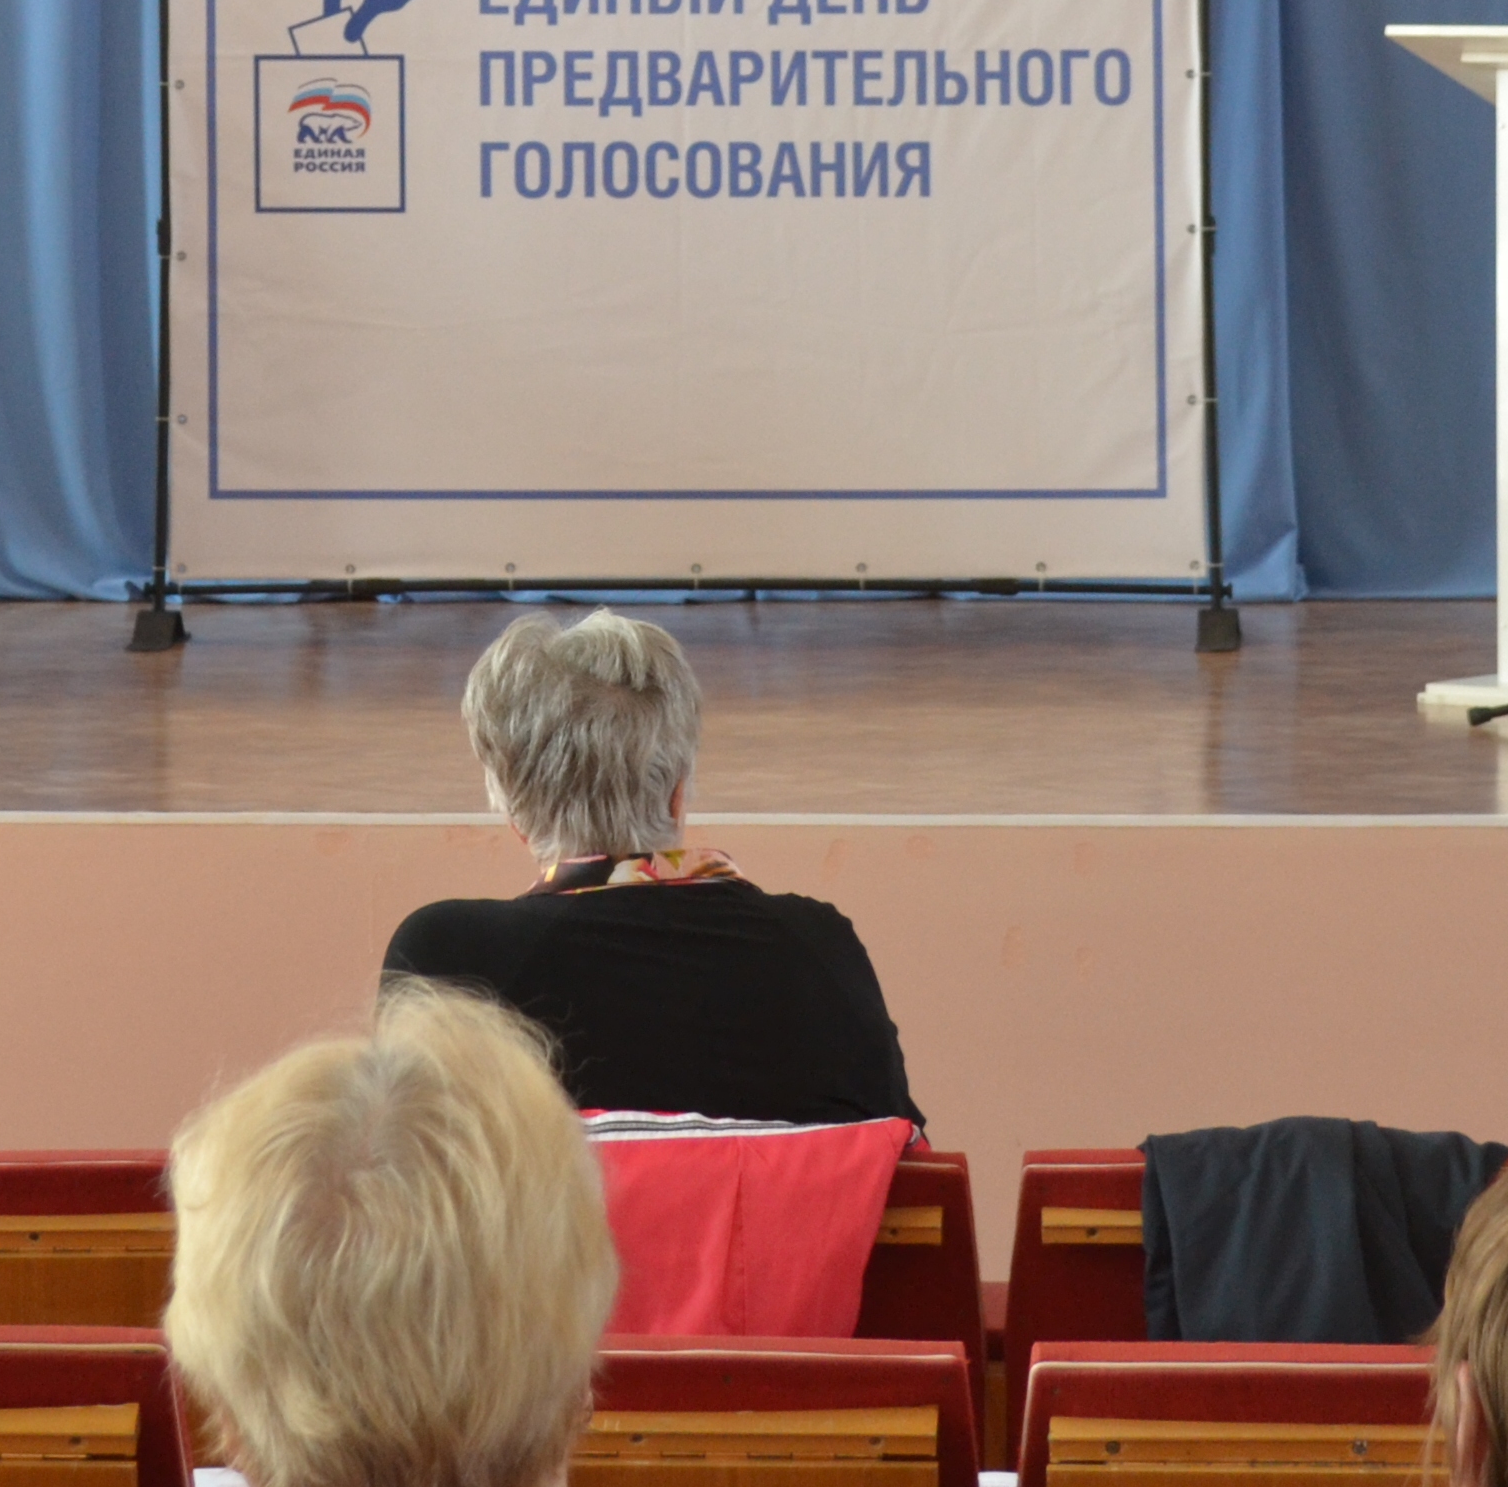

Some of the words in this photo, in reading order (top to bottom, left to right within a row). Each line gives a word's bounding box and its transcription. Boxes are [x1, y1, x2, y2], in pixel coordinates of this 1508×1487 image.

[478, 48, 1133, 117] ПРЕДВАРИТЕЛЬНОГО
[293, 148, 366, 160] ЕДИНАЯ
[293, 161, 366, 173] РОССИЯ
[479, 140, 932, 199] ГОЛОСОВАНИЯ
